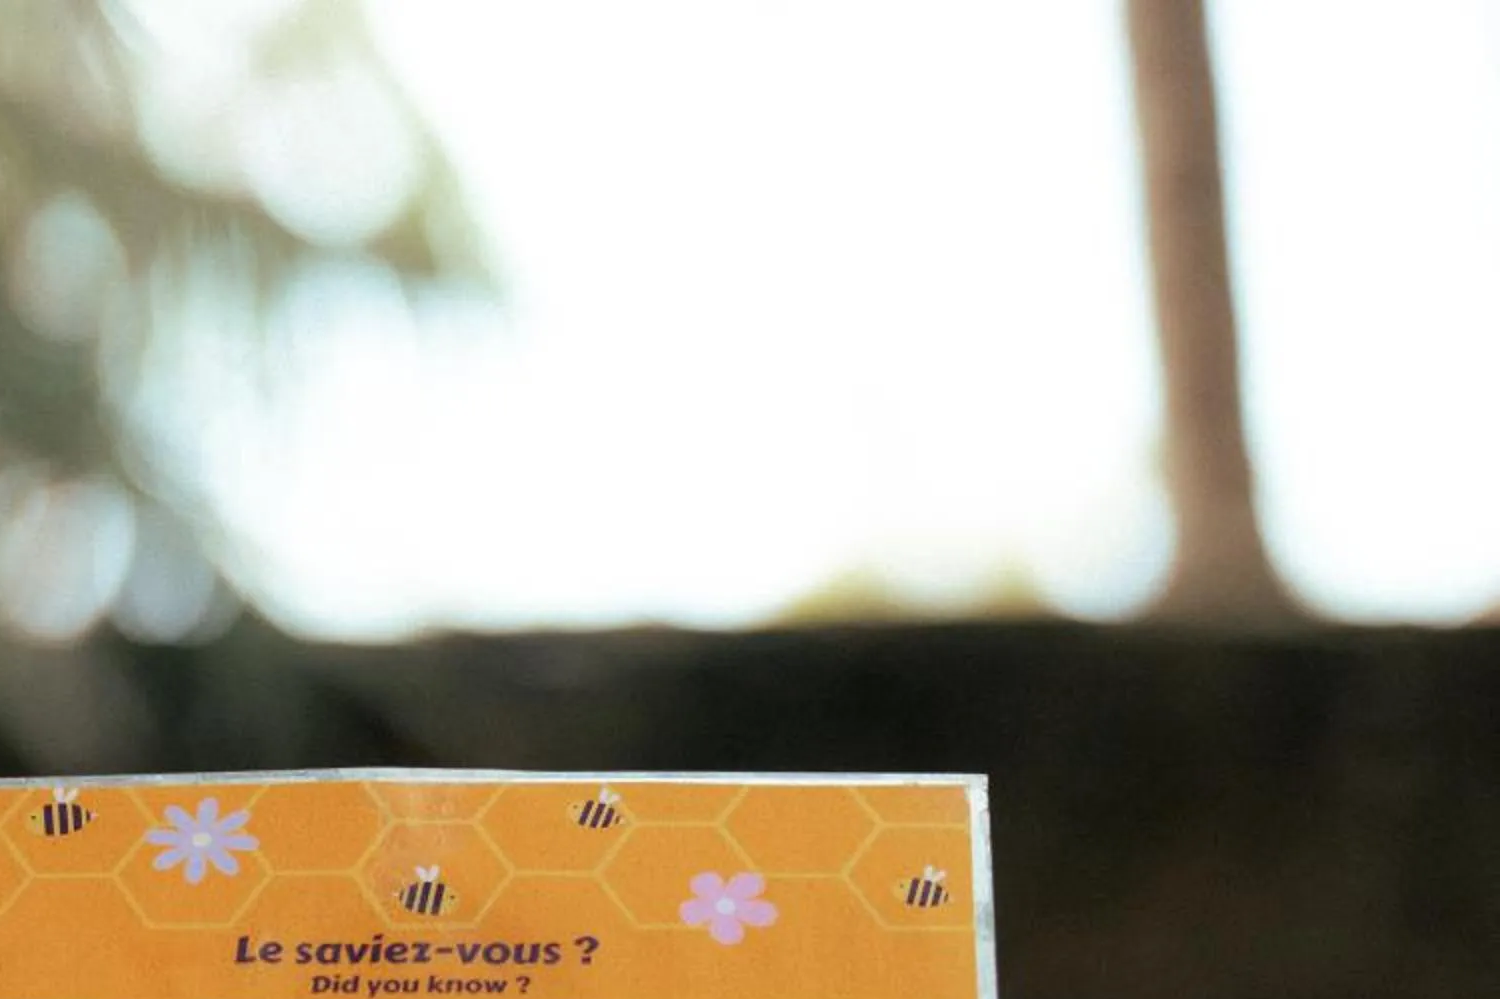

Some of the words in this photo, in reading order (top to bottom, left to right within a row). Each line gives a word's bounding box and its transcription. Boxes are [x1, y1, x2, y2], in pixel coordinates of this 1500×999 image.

[234, 935, 283, 964] Le
[294, 934, 562, 965] saviez-vous
[574, 936, 600, 965] ?
[311, 975, 360, 993] Did
[367, 977, 419, 998] you
[427, 975, 508, 993] know
[515, 976, 531, 993] ?
